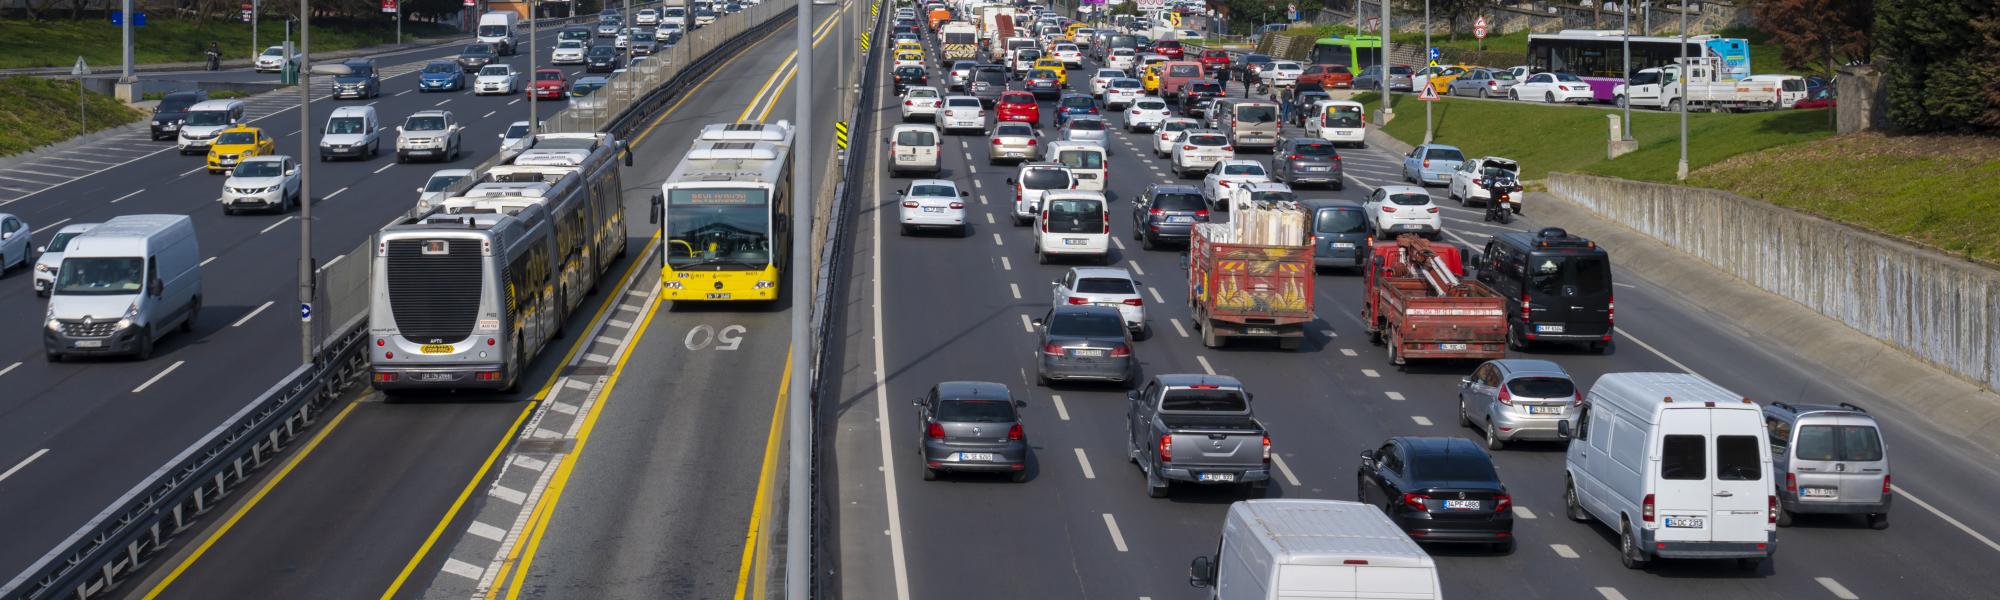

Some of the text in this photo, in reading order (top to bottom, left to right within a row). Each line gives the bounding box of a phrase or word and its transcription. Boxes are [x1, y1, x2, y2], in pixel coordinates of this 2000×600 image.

[685, 324, 747, 351] 50
[1447, 500, 1455, 508] 34
[1677, 519, 1688, 527] DC
